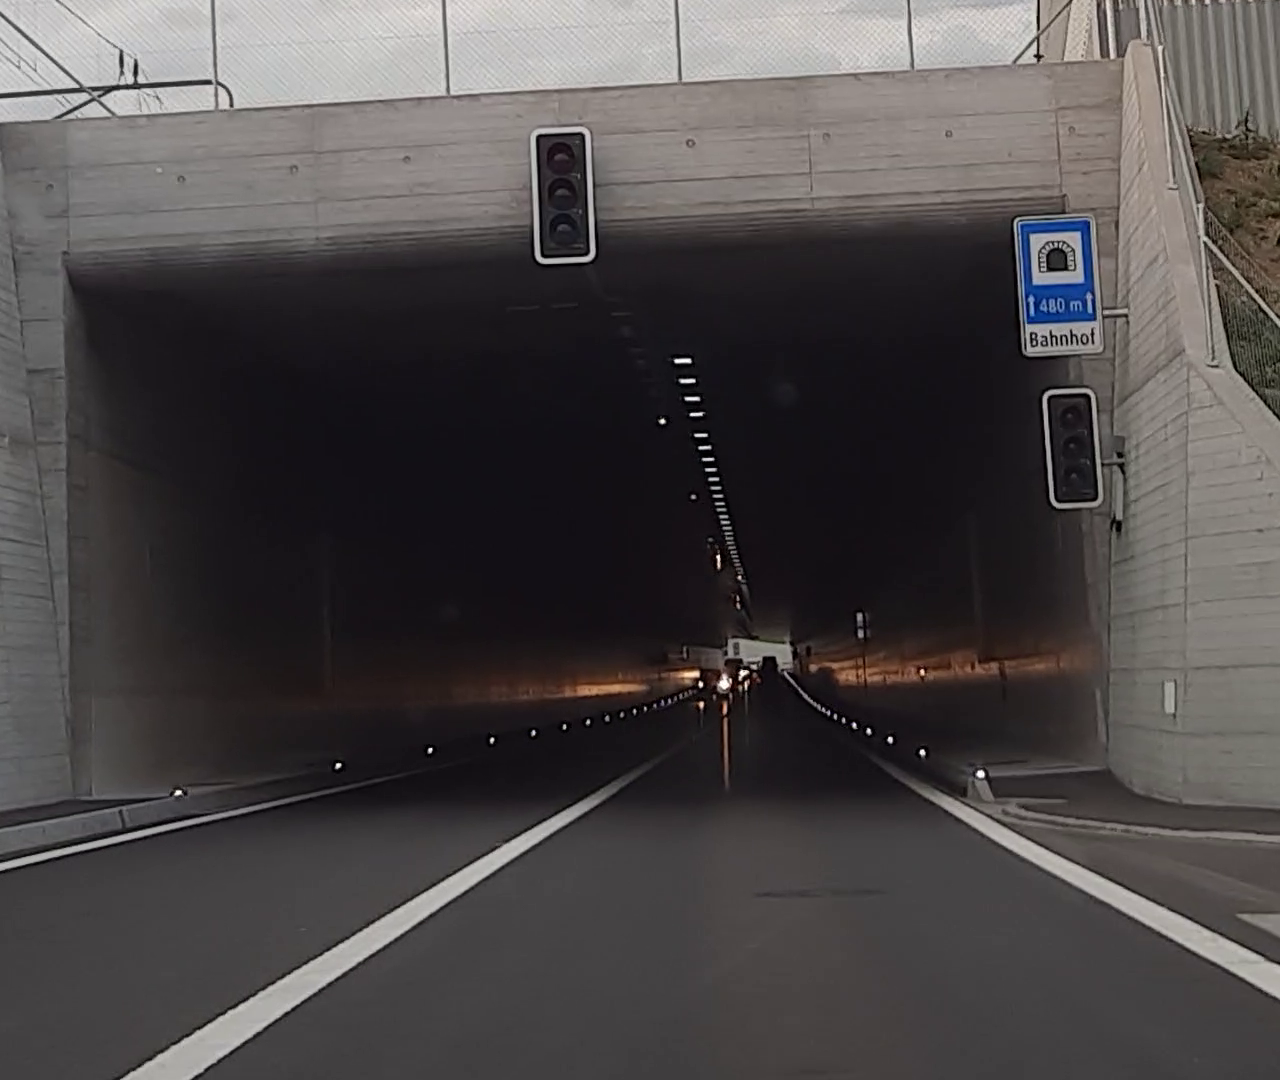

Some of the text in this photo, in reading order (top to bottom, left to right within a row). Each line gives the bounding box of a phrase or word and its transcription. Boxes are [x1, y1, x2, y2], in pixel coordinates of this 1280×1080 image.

[1039, 298, 1082, 314] 480 m
[1029, 327, 1096, 348] Bahnhof
